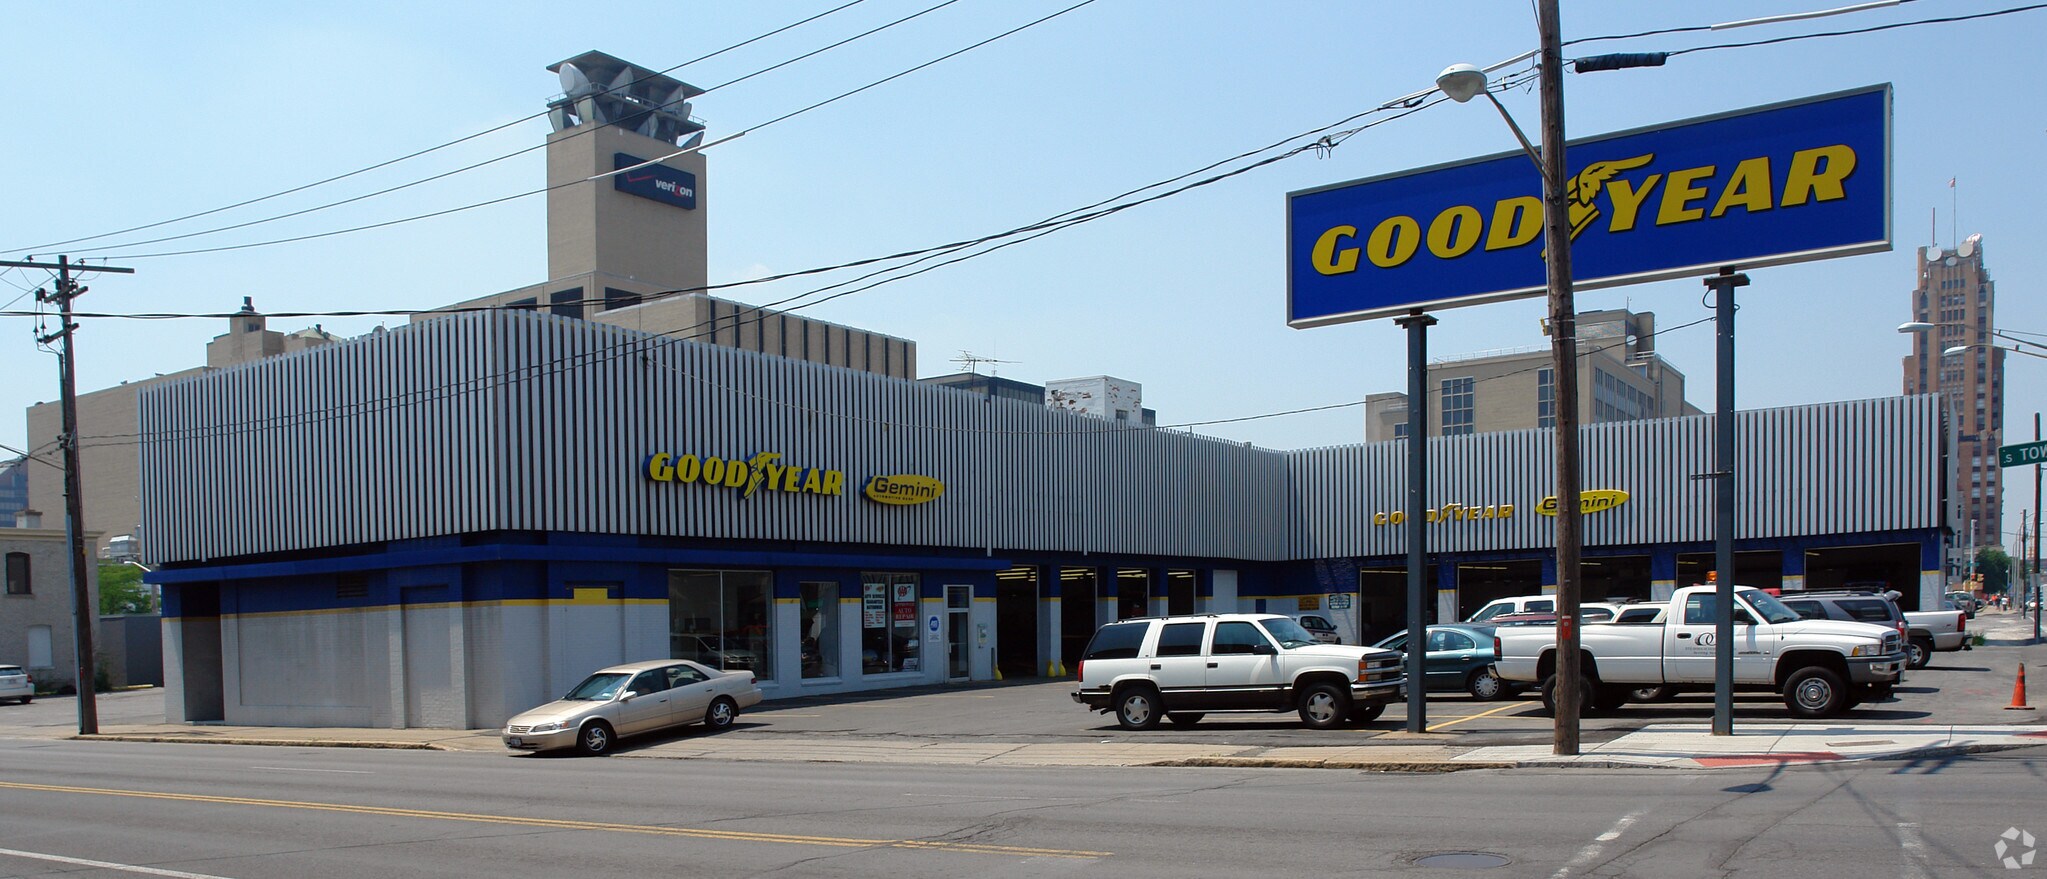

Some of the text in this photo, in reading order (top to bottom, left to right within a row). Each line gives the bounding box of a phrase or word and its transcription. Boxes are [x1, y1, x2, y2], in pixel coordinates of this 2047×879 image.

[655, 179, 693, 197] verizon
[2005, 454, 2013, 463] S
[874, 477, 937, 498] Gemini
[1373, 503, 1515, 526] GODYEAR
